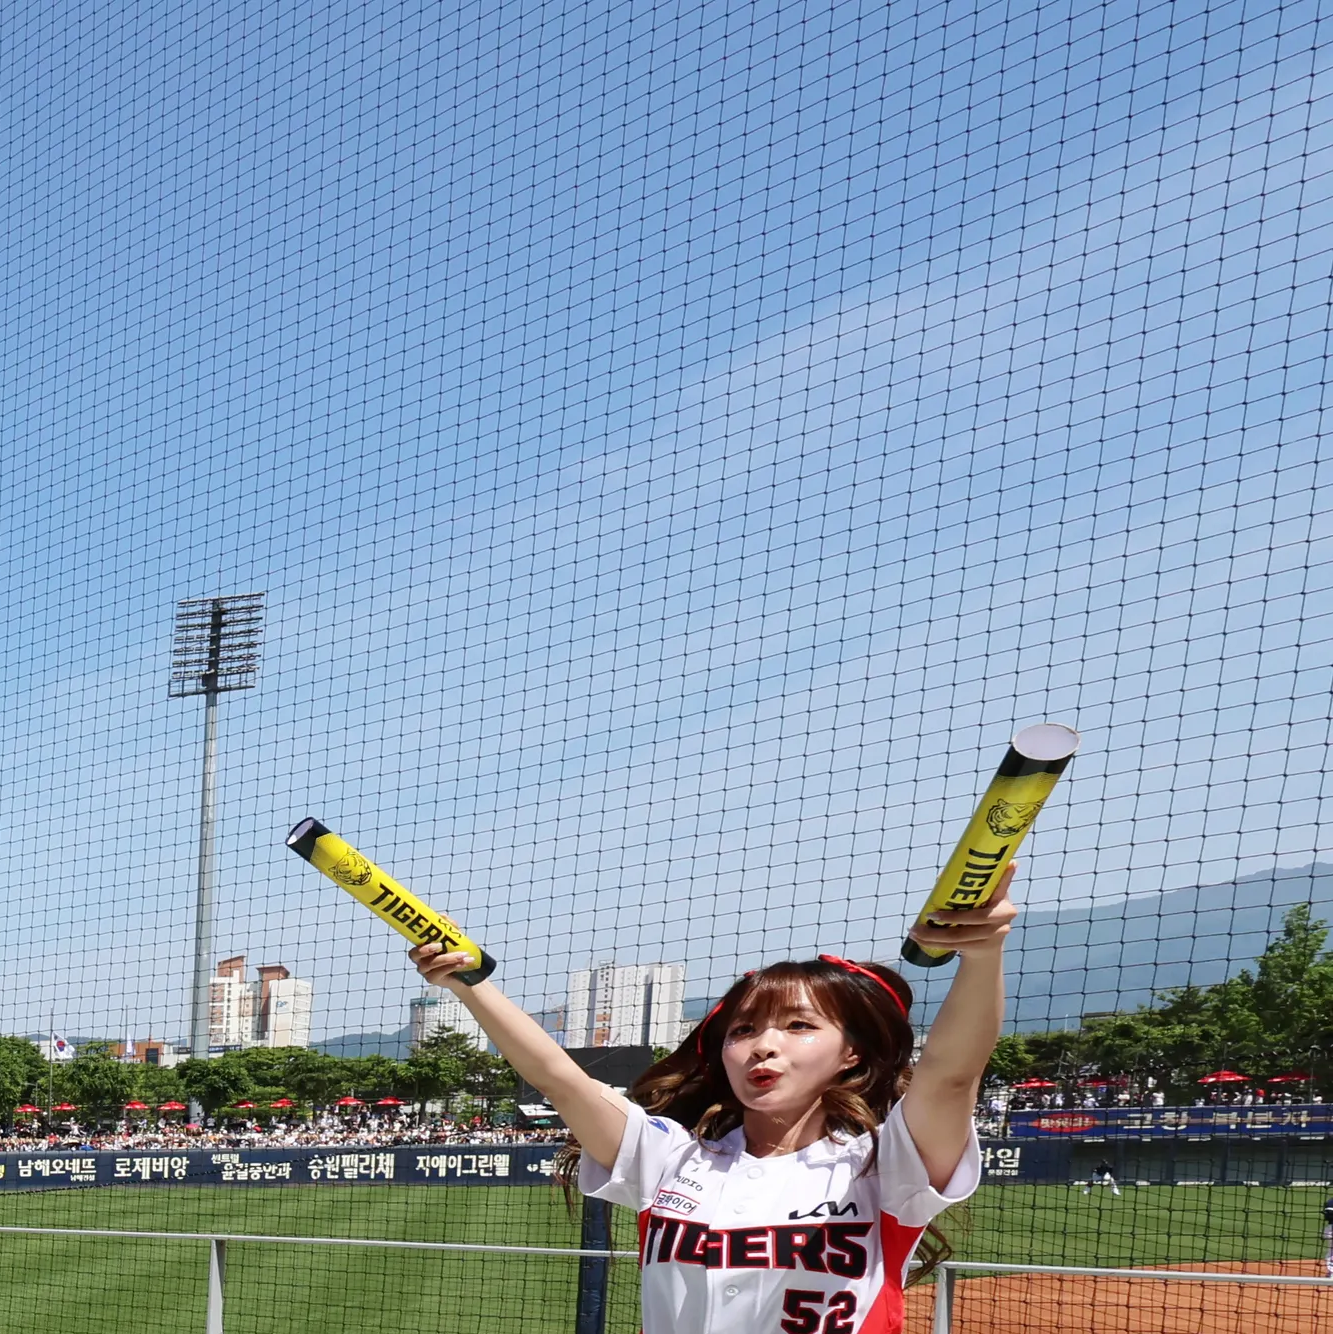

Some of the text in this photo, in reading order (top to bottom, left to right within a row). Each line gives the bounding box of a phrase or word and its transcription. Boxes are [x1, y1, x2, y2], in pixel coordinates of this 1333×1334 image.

[114, 1157, 190, 1179] 로제비앙
[307, 1153, 394, 1179] 승원팰리체
[416, 1154, 510, 1178] 지에이그린웰
[646, 1214, 874, 1280] TIGERS
